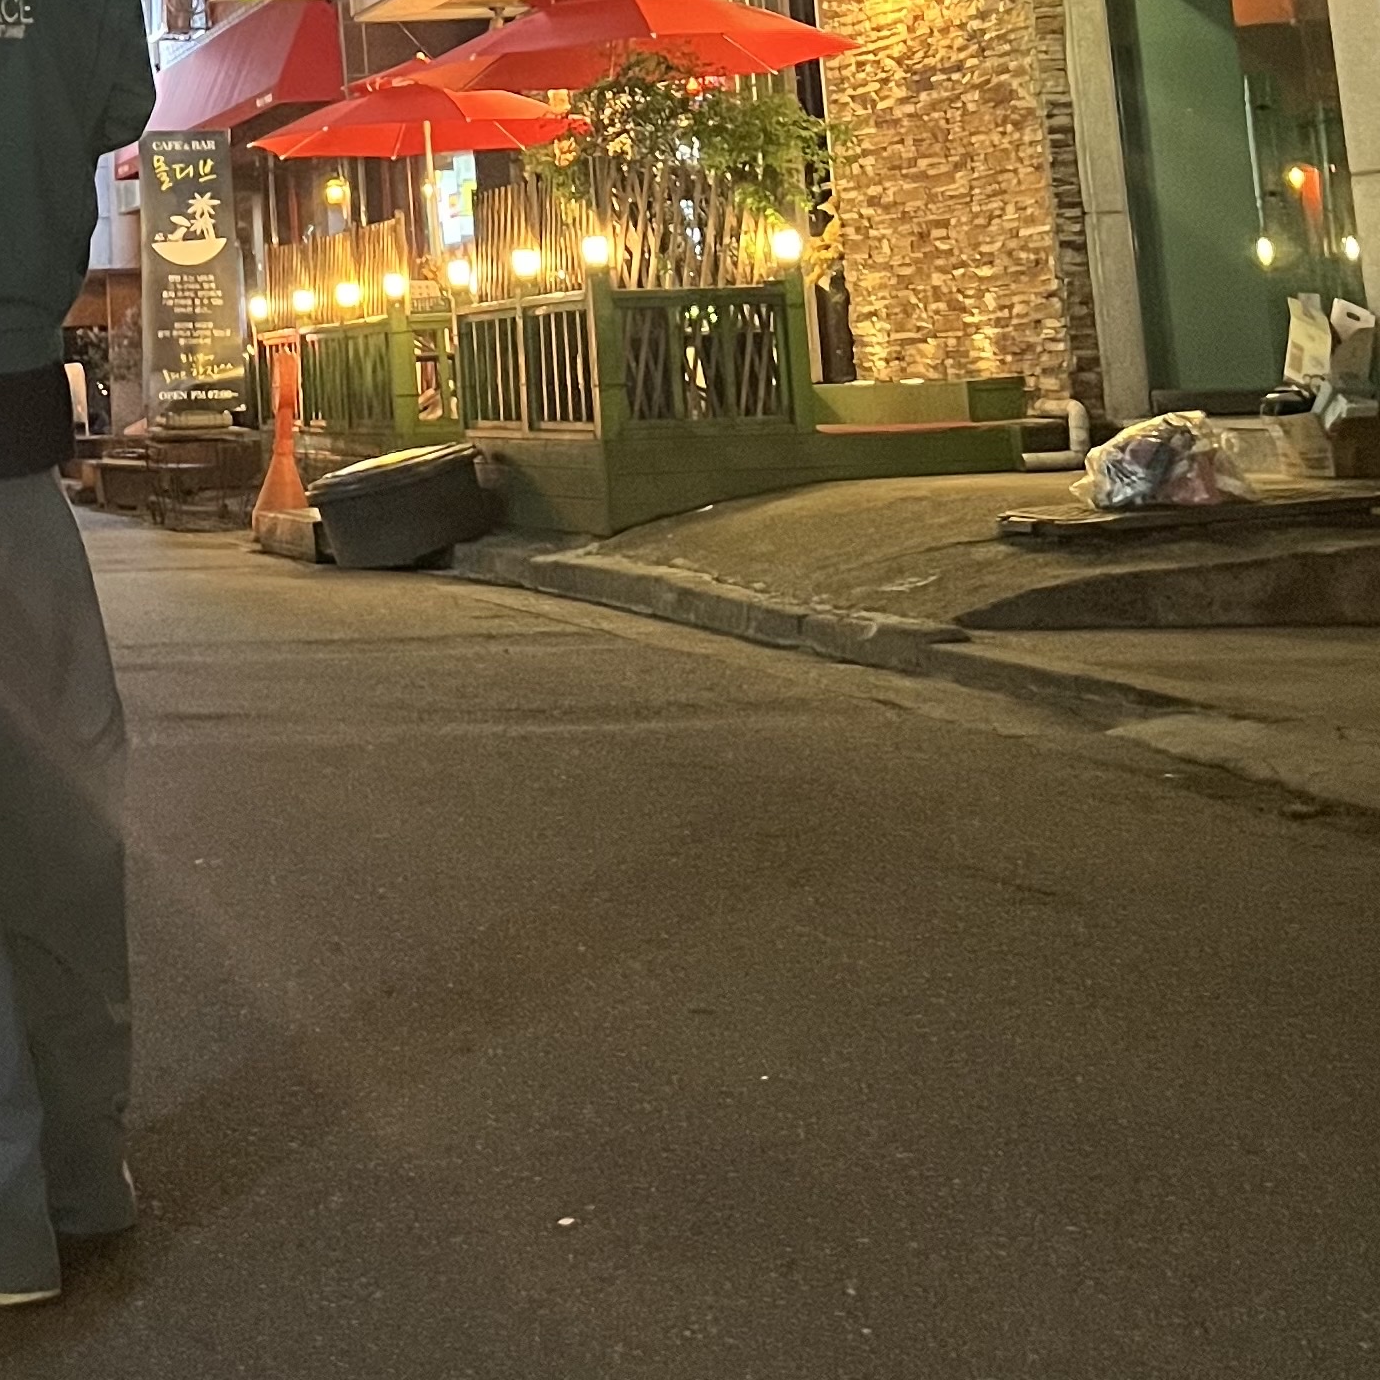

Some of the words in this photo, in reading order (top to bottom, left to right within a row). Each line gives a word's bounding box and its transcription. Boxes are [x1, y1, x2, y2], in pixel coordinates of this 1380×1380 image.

[191, 140, 216, 151] BAR
[153, 155, 217, 191] 몰디브
[158, 390, 188, 401] OPEN
